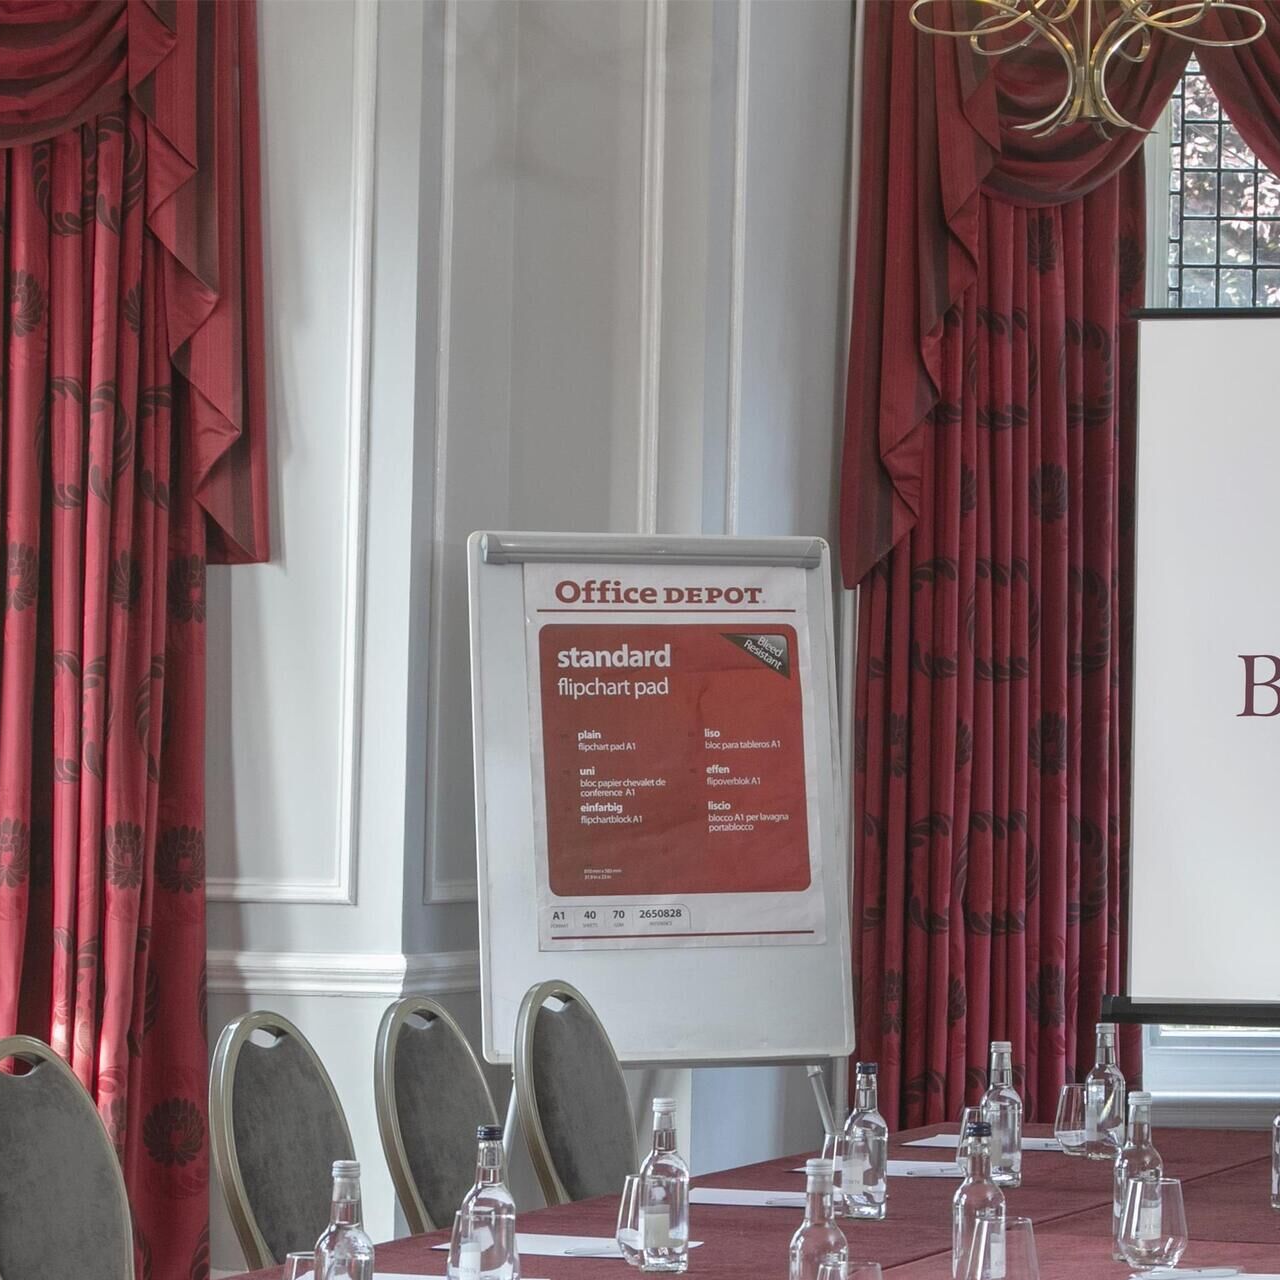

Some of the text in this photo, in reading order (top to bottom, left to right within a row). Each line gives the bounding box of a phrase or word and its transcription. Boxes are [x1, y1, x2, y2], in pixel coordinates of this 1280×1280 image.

[554, 579, 763, 604] Office DEPOT
[757, 635, 784, 658] Bleed
[557, 643, 671, 668] standard
[743, 639, 783, 670] Resistant
[557, 676, 669, 700] flipchart pad
[577, 730, 602, 741] plain
[704, 728, 721, 738] liso
[578, 742, 637, 752] flipchart pad A1
[705, 740, 781, 751] bloc para tableros A1
[579, 766, 596, 776] uni
[706, 764, 730, 774] effen
[580, 779, 597, 788] bloc
[598, 778, 622, 789] papier
[655, 778, 666, 786] de
[751, 777, 761, 785] A1
[580, 788, 636, 797] conference A1
[580, 802, 623, 813] einfarbig
[707, 801, 732, 811] liscio
[632, 815, 643, 823] A1
[708, 812, 789, 822] blocco A1 per lavagna
[708, 823, 754, 833] portablocco
[552, 908, 682, 920] A1 40 70 2650828
